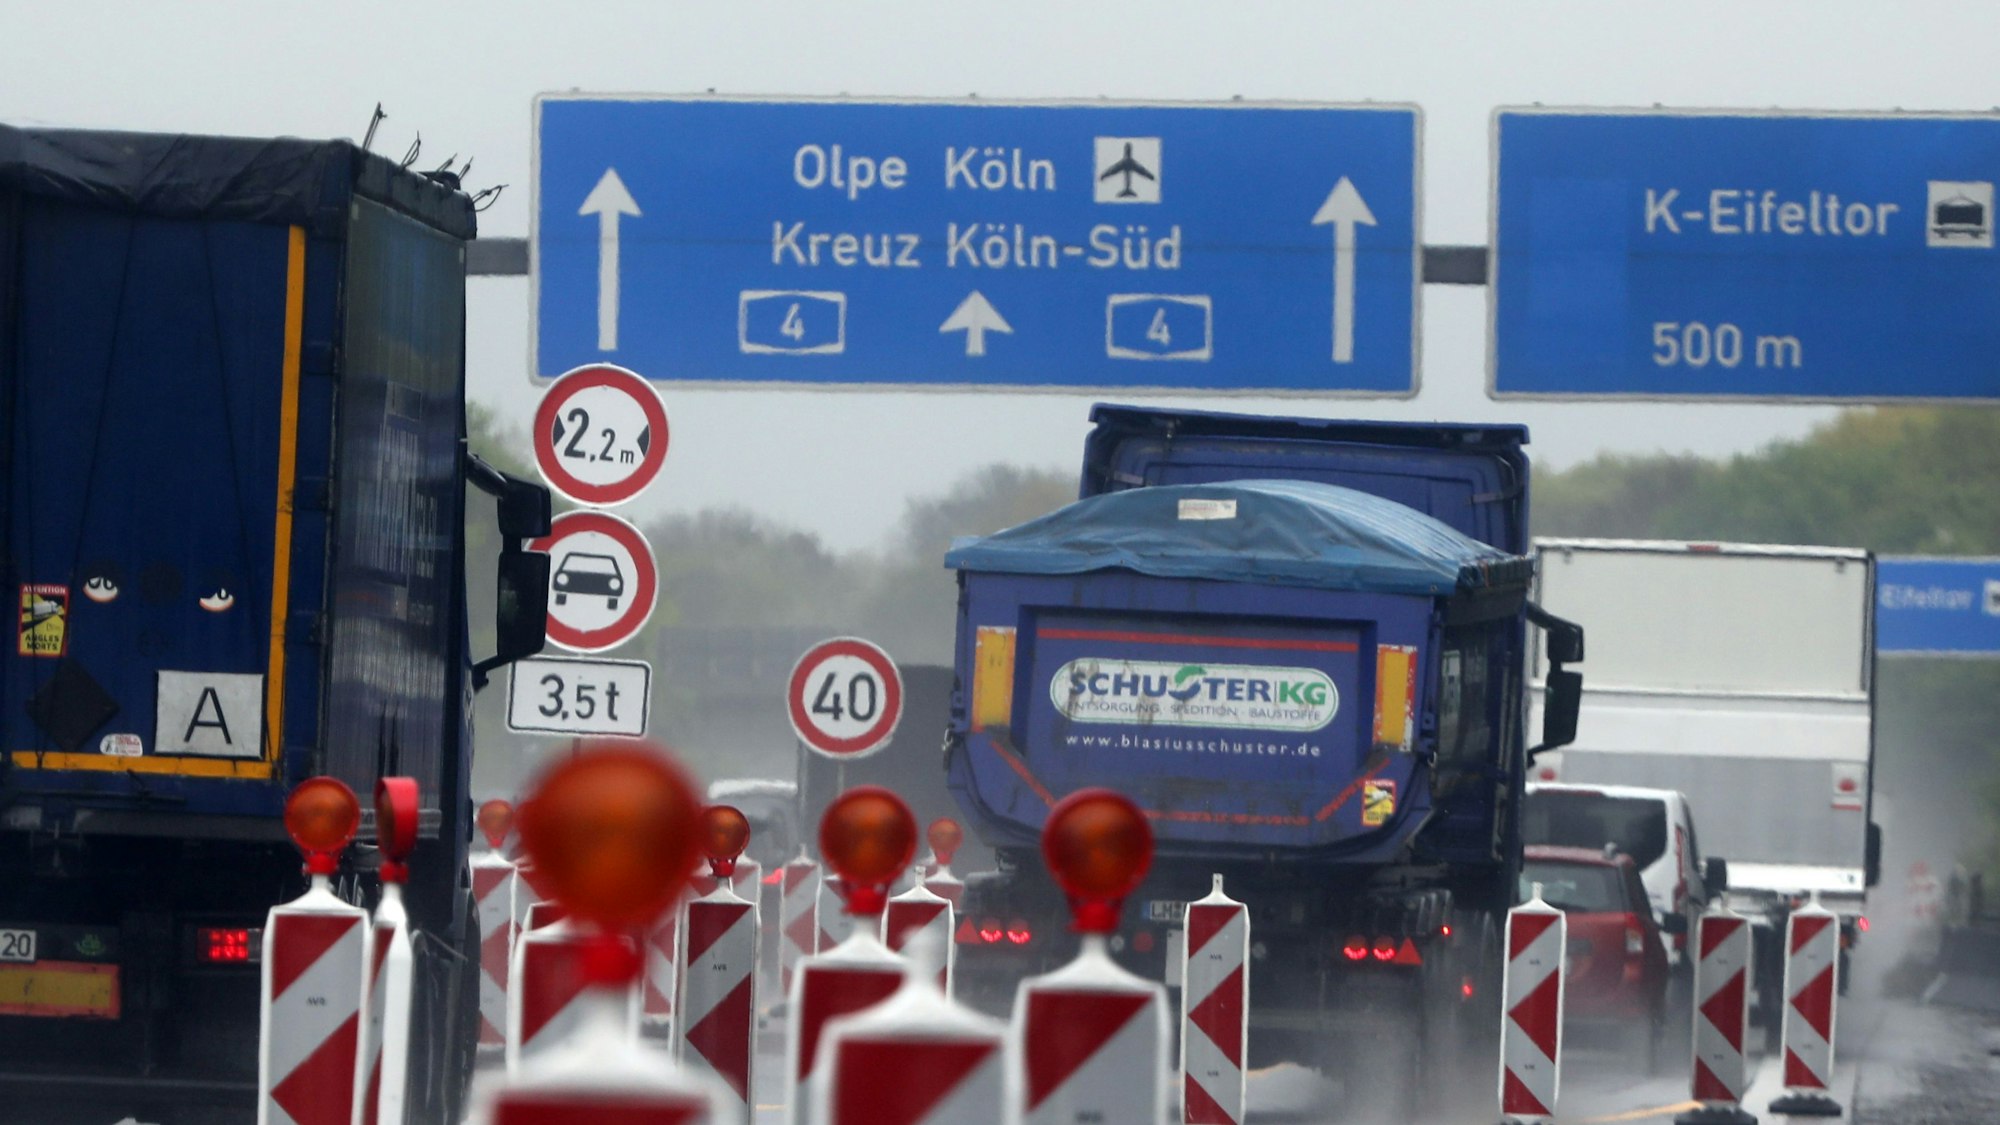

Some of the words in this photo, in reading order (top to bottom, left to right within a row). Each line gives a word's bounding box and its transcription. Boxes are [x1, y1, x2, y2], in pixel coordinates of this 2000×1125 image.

[793, 144, 908, 201] Olpe
[945, 145, 1057, 191] Köln
[1645, 188, 1900, 236] K-Eifeltor
[771, 220, 921, 266] Kreuz
[946, 222, 1182, 269] Köln-Süd
[779, 302, 805, 341] 4
[1145, 307, 1172, 346] 4
[1652, 321, 1743, 368] 500
[1755, 334, 1802, 368] m
[563, 407, 616, 463] 2,2
[620, 450, 635, 464] m
[183, 686, 233, 745] A
[538, 673, 596, 720] 3,5
[605, 681, 620, 721] t
[812, 672, 876, 722] 40
[1066, 734, 1321, 757] www.blasiusschuster.de
[2, 932, 31, 957] 20
